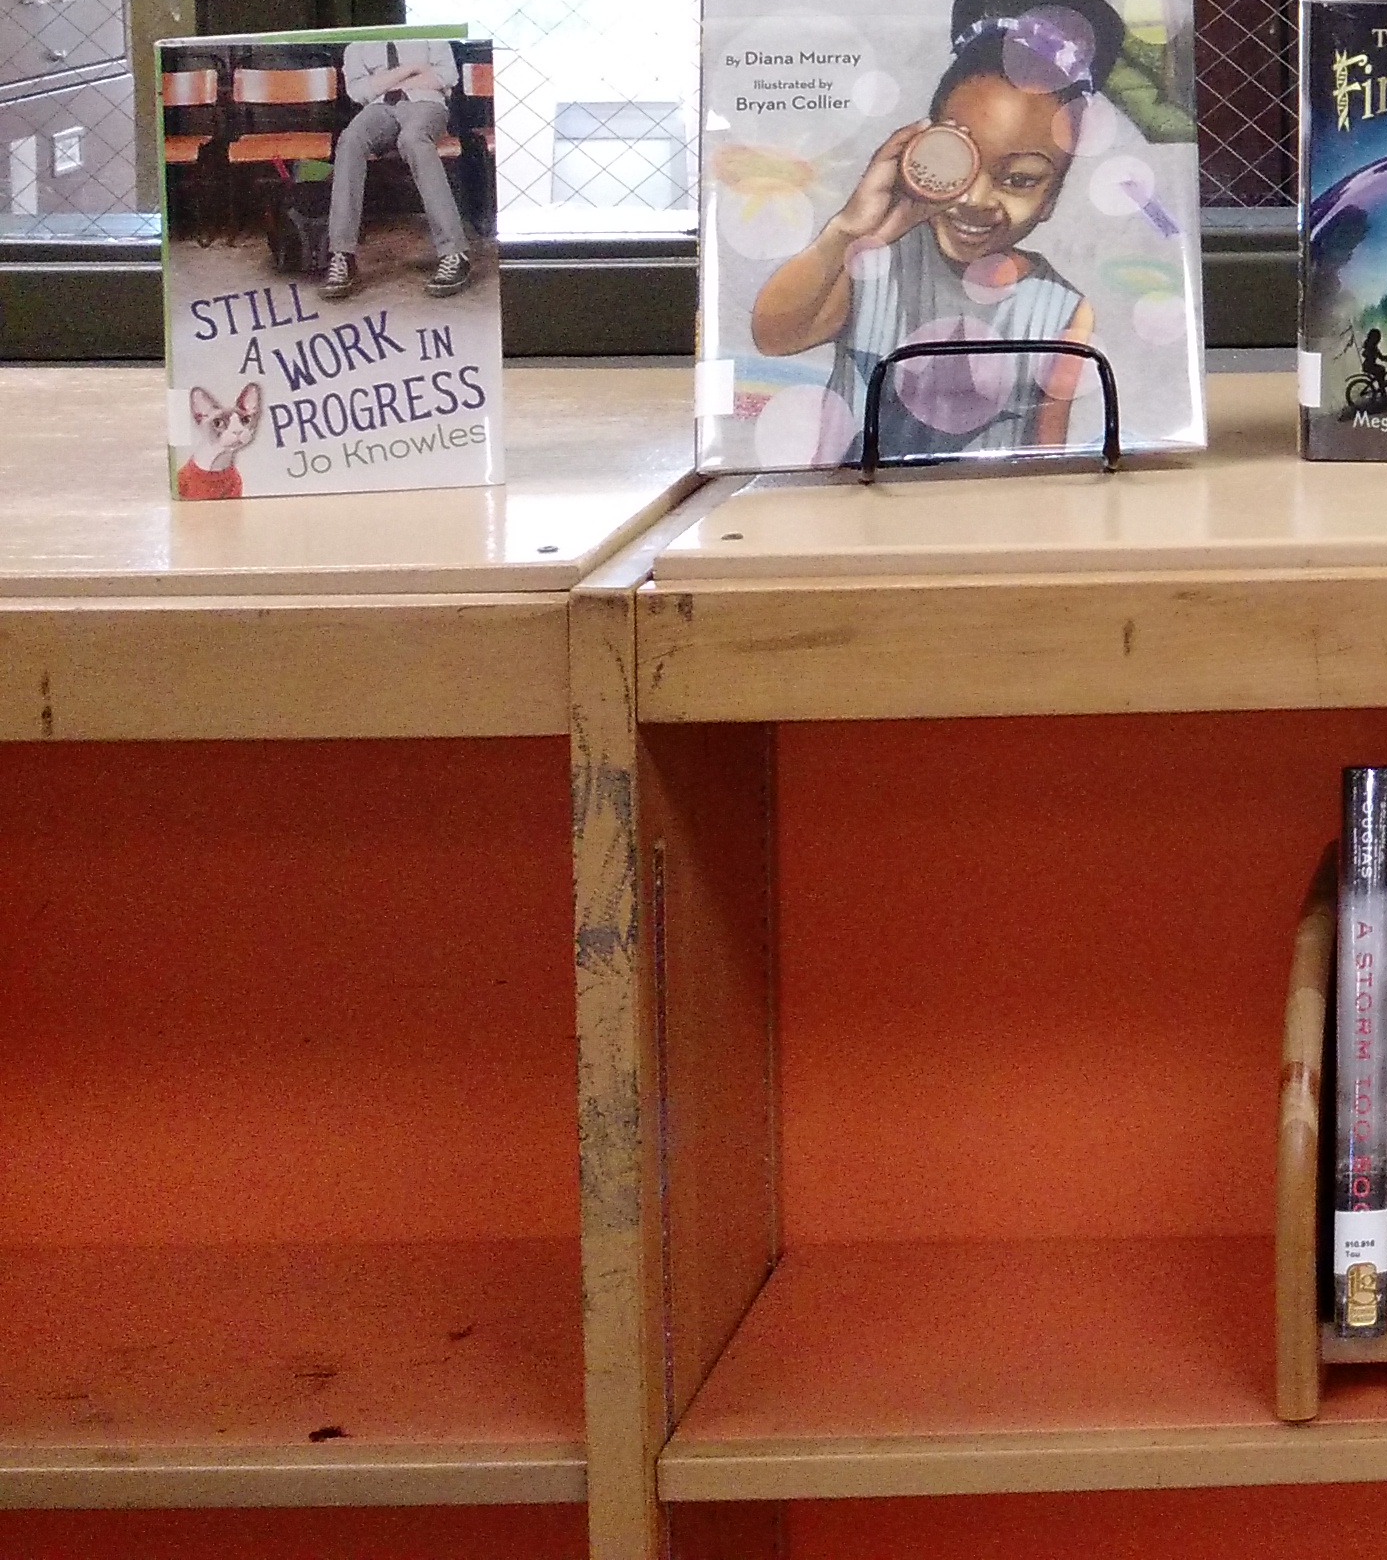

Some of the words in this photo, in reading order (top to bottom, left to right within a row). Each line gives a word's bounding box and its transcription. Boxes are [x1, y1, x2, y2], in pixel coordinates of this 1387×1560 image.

[725, 54, 741, 69] By
[745, 50, 794, 66] Diana
[799, 50, 861, 70] Murray
[753, 78, 816, 90] Illustrated
[819, 78, 833, 92] by
[735, 95, 787, 114] Bryan
[791, 94, 851, 112] Collier
[191, 283, 319, 341] STILL
[239, 337, 265, 375] A
[273, 310, 407, 393] WORK
[416, 325, 455, 362] IN
[268, 365, 487, 449] PROGRESS
[287, 448, 332, 480] Jo
[342, 419, 487, 468] Knowles
[1357, 921, 1373, 939] A
[1355, 952, 1373, 1060] STORM
[1353, 1074, 1371, 1140] TOO
